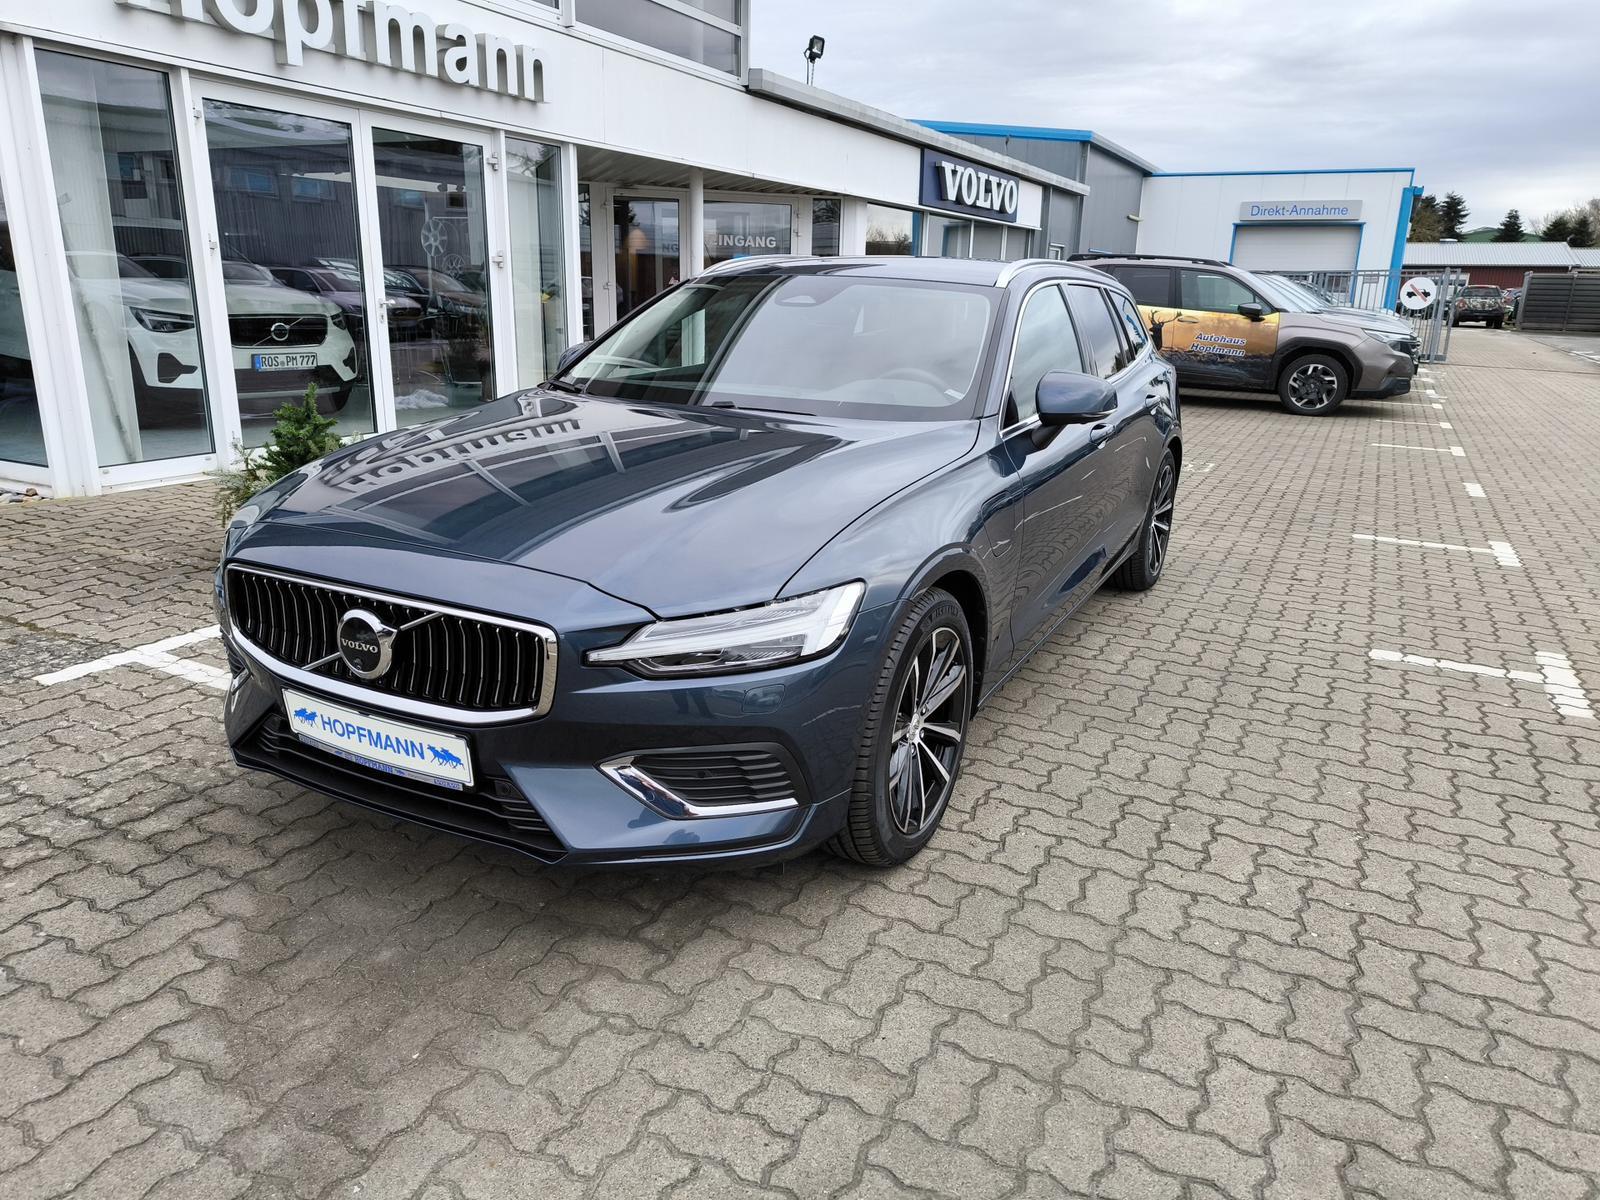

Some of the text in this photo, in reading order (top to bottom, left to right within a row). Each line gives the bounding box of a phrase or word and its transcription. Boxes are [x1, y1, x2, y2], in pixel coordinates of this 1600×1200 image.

[114, 0, 552, 104] pfmann
[939, 160, 1018, 215] VOLVO
[1250, 203, 1349, 217] Direkt-Annahme
[713, 234, 777, 249] INGANG
[1195, 332, 1247, 347] Autohaus
[1190, 342, 1246, 357] Hopfmann
[261, 354, 316, 368] ROS PM 777
[341, 638, 379, 654] VOLVO
[320, 713, 426, 760] HOPFMANN
